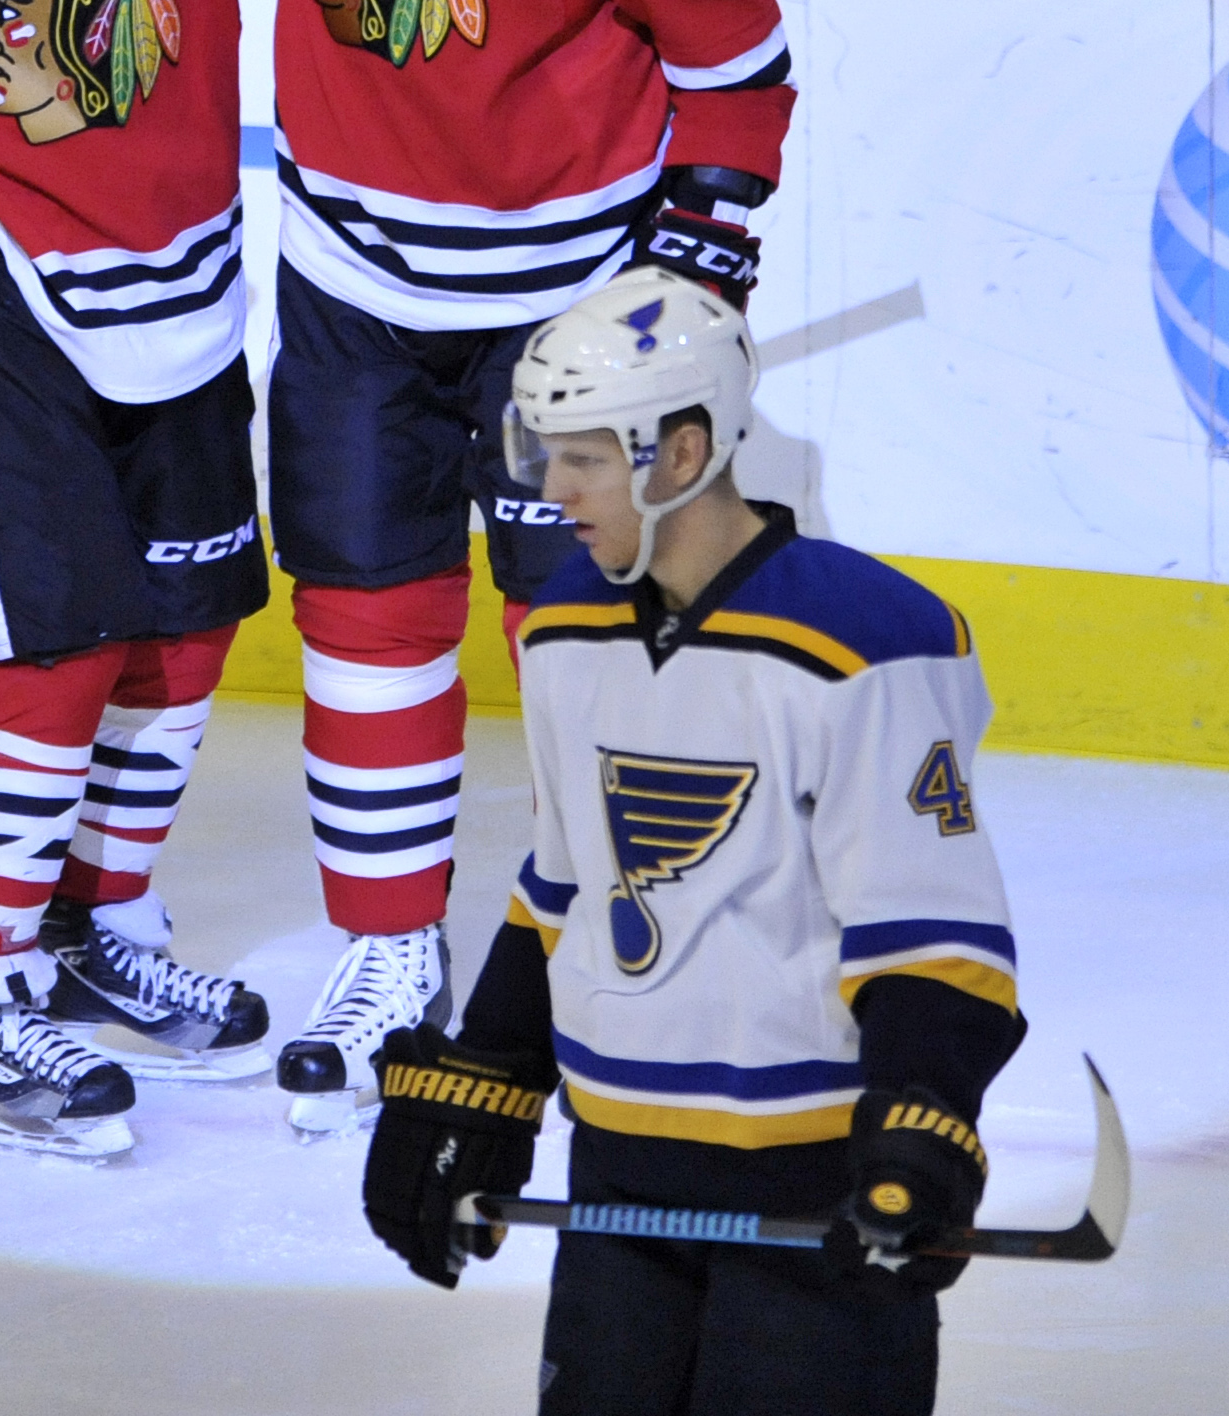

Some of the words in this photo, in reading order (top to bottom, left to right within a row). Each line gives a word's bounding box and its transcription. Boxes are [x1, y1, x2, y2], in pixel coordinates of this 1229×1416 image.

[648, 229, 759, 285] CCM
[494, 496, 578, 526] CC
[145, 514, 256, 563] CCM
[906, 739, 976, 837] 4
[383, 1062, 547, 1126] WARRIO
[570, 1203, 761, 1243] WARRIOR
